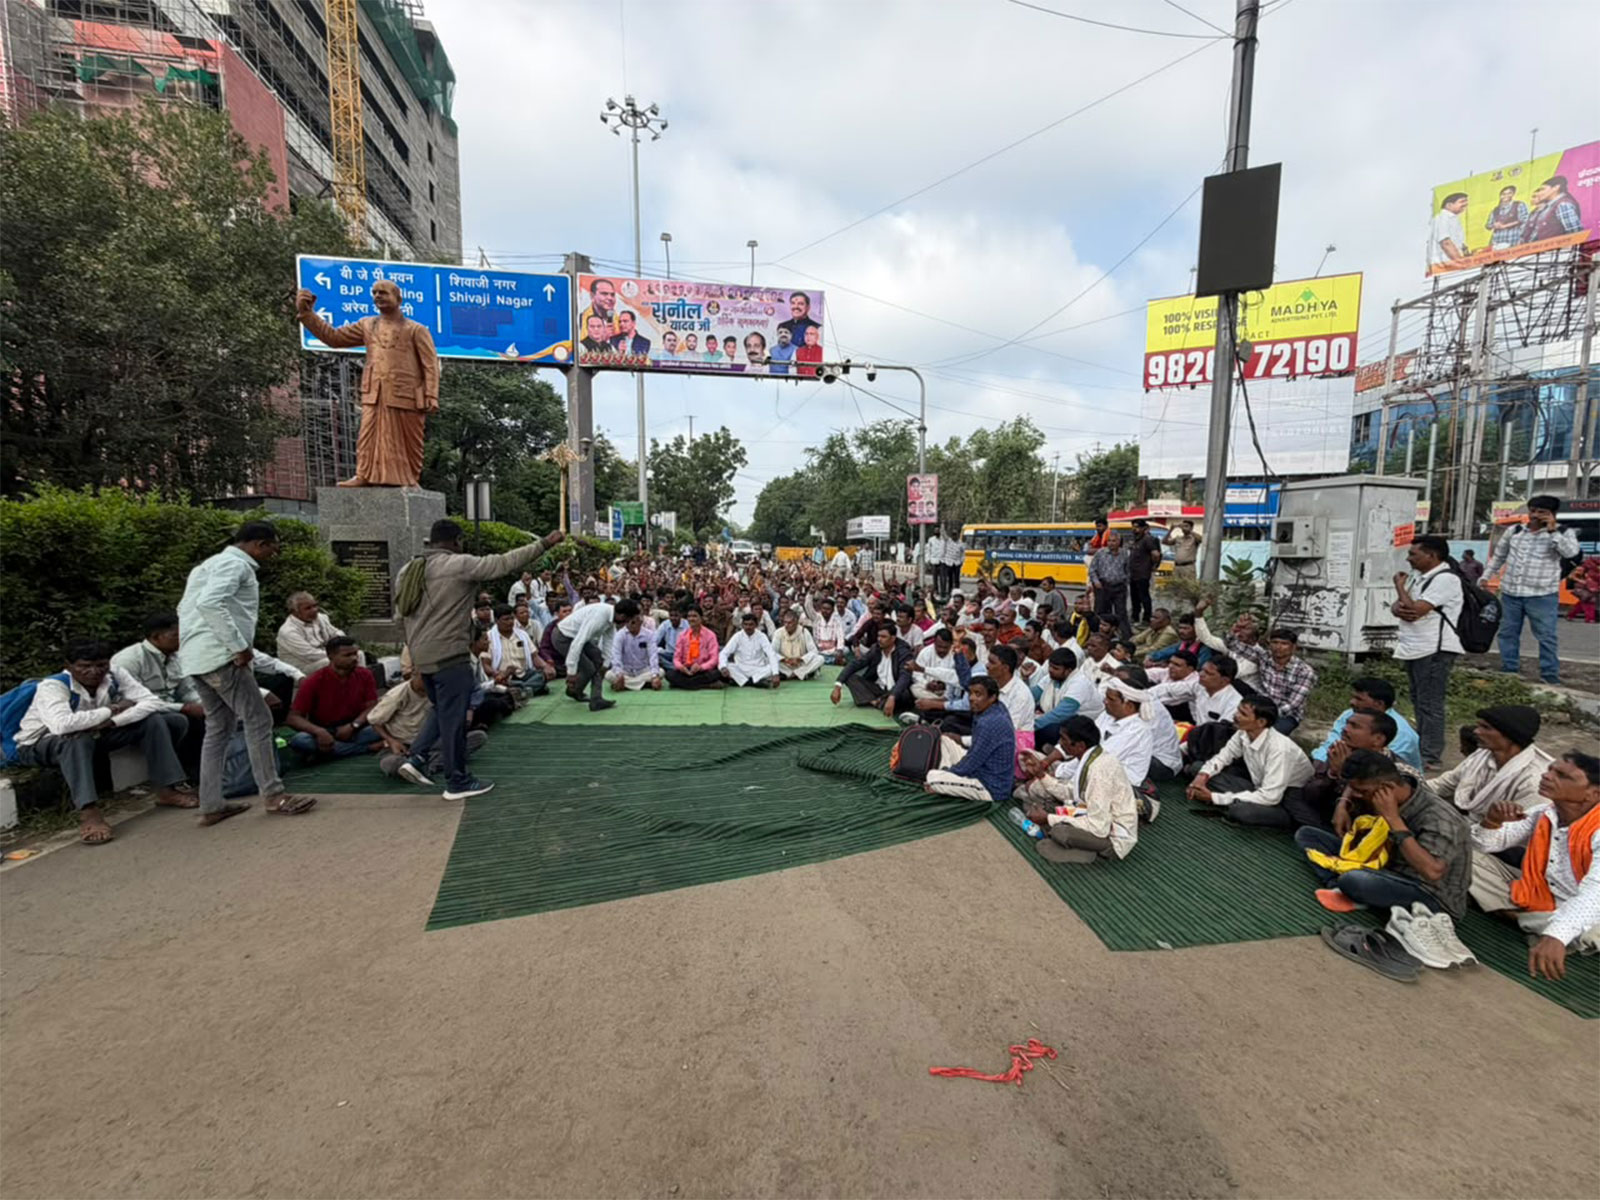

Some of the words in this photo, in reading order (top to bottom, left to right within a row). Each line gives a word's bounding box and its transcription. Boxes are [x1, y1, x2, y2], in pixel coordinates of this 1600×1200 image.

[355, 267, 368, 280] जे
[448, 272, 489, 289] शिवाजी
[492, 279, 517, 290] नगर
[340, 284, 363, 296] BJP
[449, 291, 490, 307] Shivaji
[496, 295, 534, 308] Nagar
[650, 298, 703, 324] सुनील
[1270, 300, 1338, 317] MADHYA
[669, 319, 695, 331] यादव
[697, 317, 711, 332] जी
[1163, 311, 1192, 324] 100%
[1270, 314, 1310, 323] ADVERTISING
[1163, 322, 1191, 335] 100%
[1253, 337, 1350, 377] 72190
